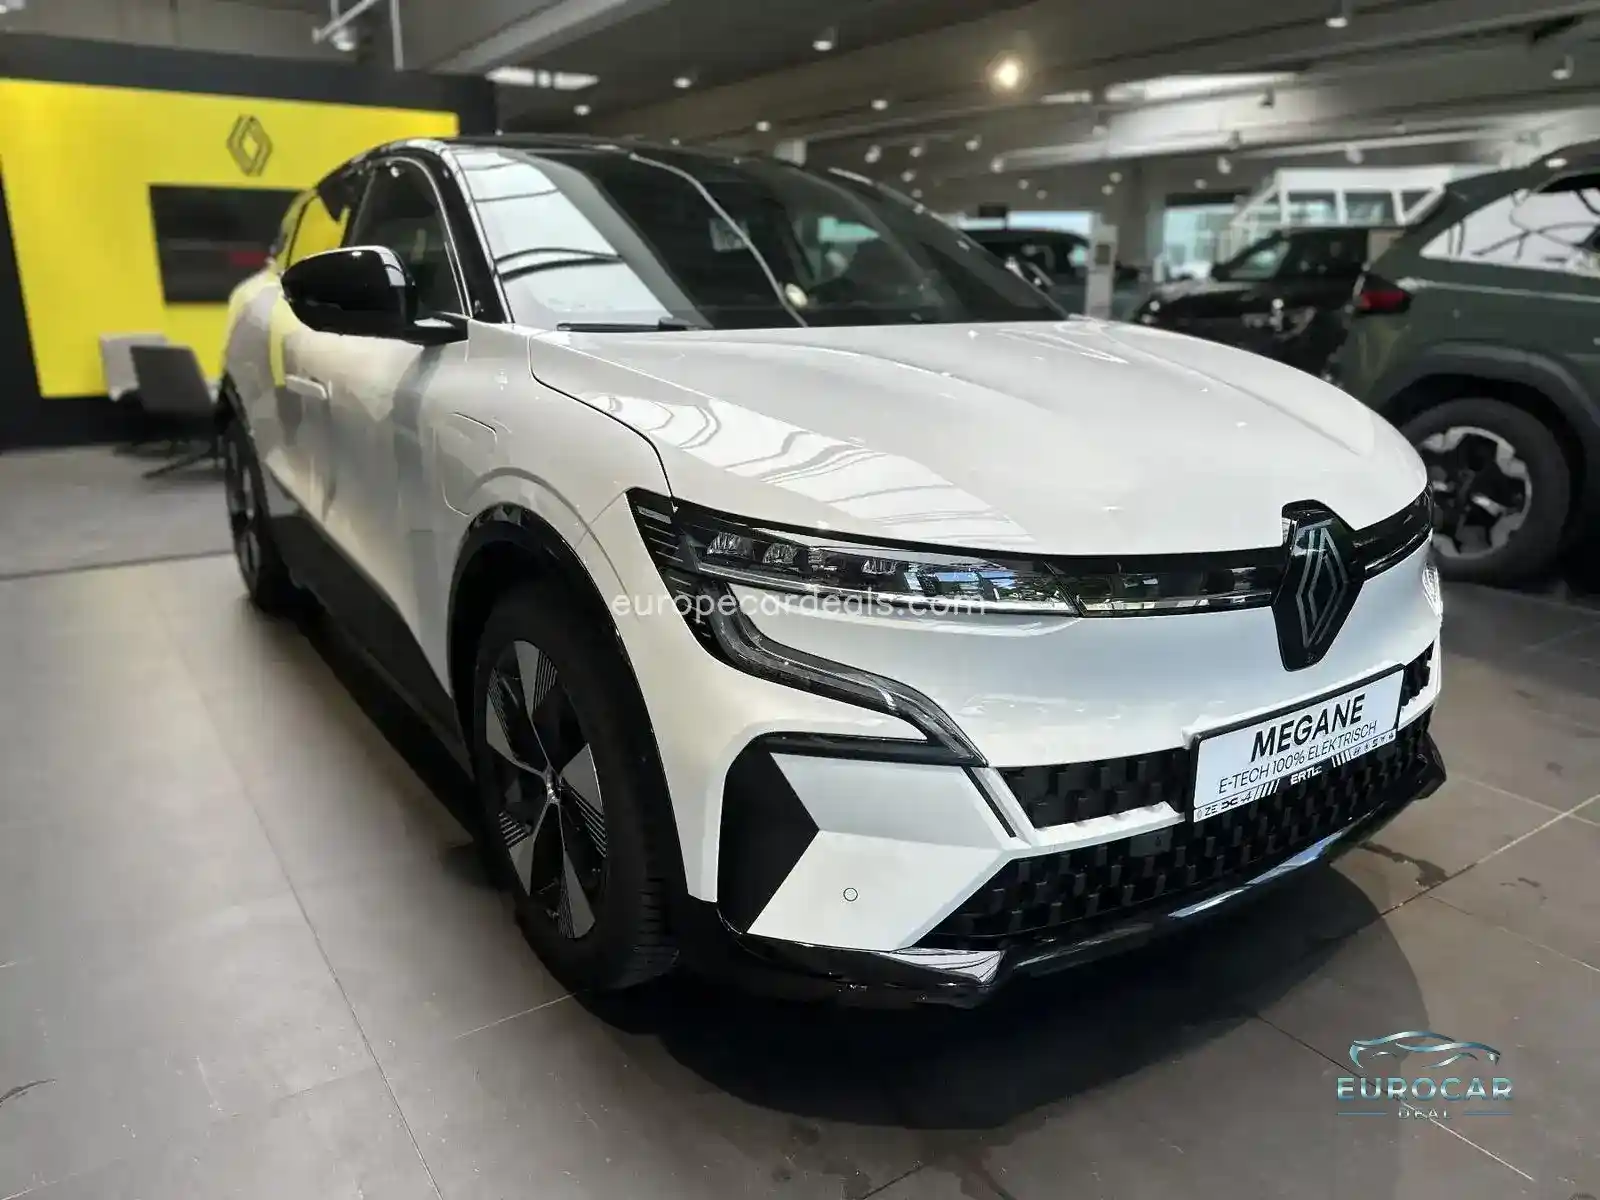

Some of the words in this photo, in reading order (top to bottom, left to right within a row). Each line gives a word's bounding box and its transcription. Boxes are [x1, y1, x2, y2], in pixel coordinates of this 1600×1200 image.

[1218, 765, 1270, 795] E-TECH
[1272, 749, 1305, 775] 100%
[1307, 720, 1377, 761] ELEKTRISCH
[1250, 693, 1366, 763] MEGANE
